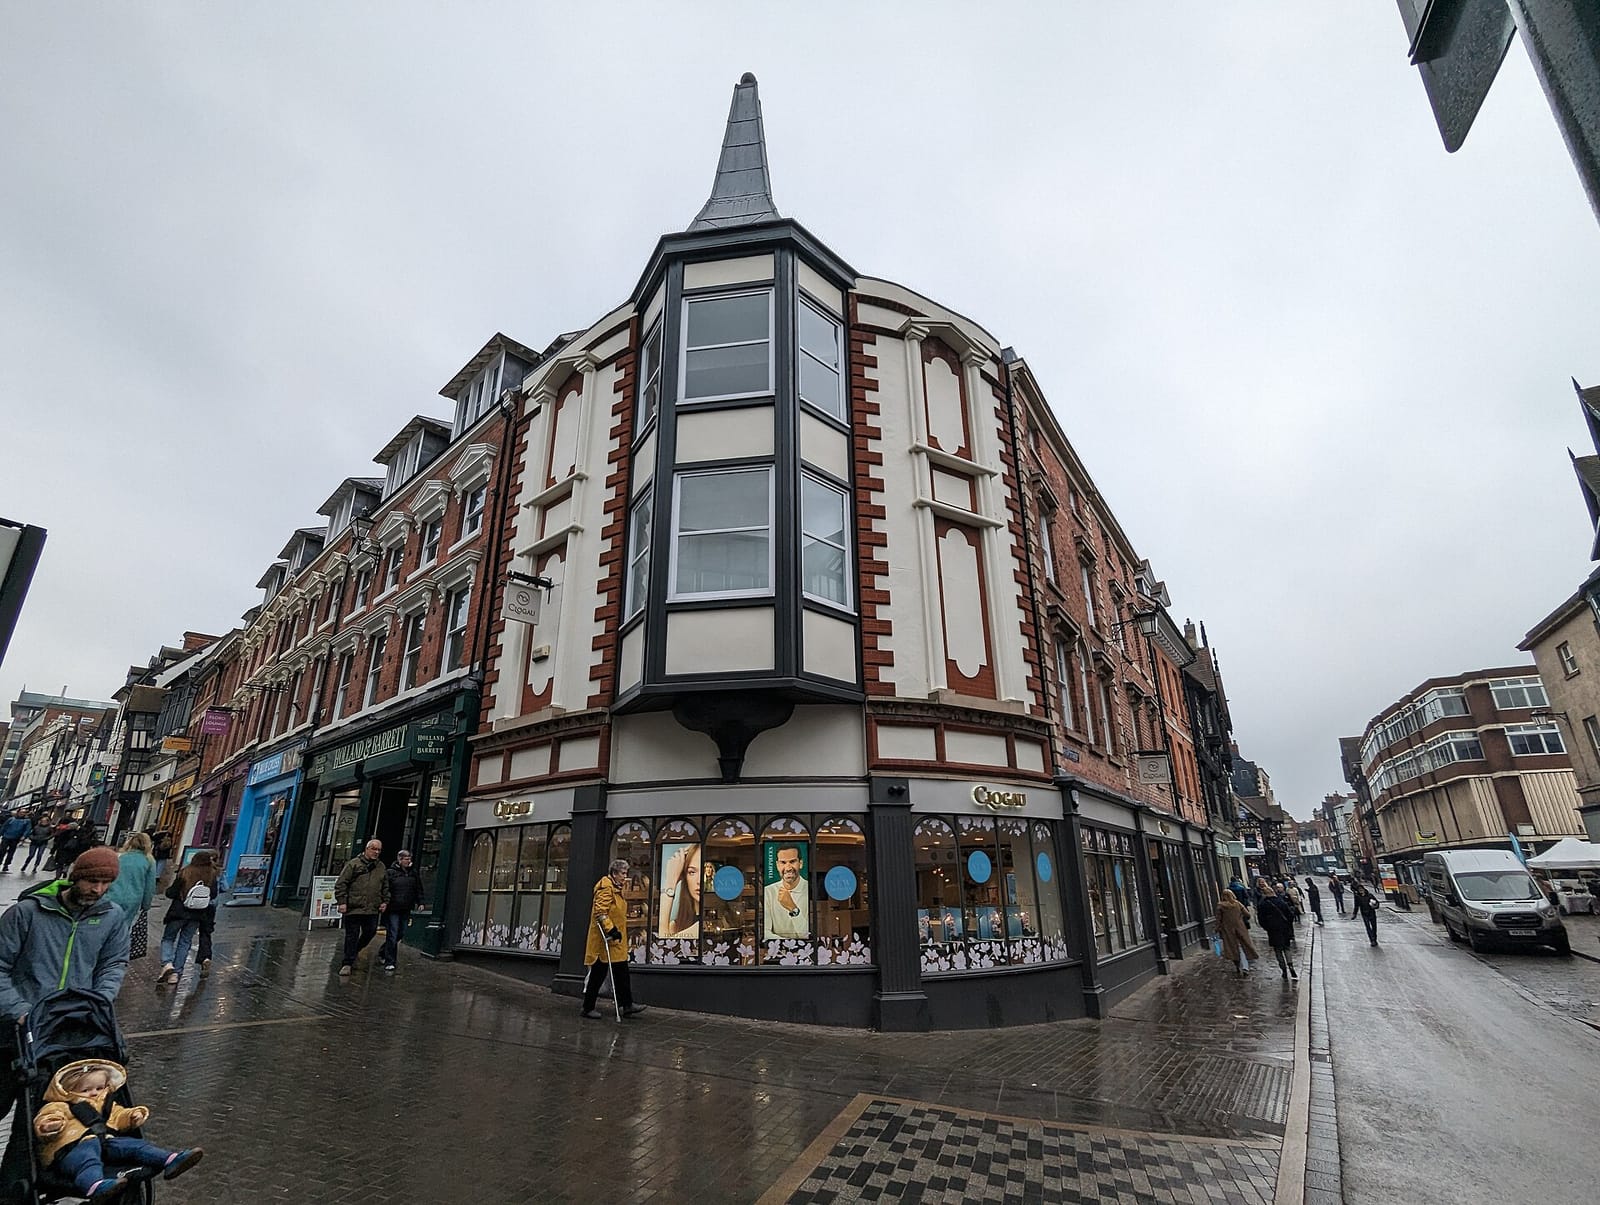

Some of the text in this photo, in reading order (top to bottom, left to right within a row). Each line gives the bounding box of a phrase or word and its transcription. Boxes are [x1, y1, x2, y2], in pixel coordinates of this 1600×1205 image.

[333, 740, 365, 769] HOLLAND
[370, 724, 408, 754] BARRETT
[417, 734, 445, 742] HOLLAND
[973, 785, 1027, 811] CLOGAU
